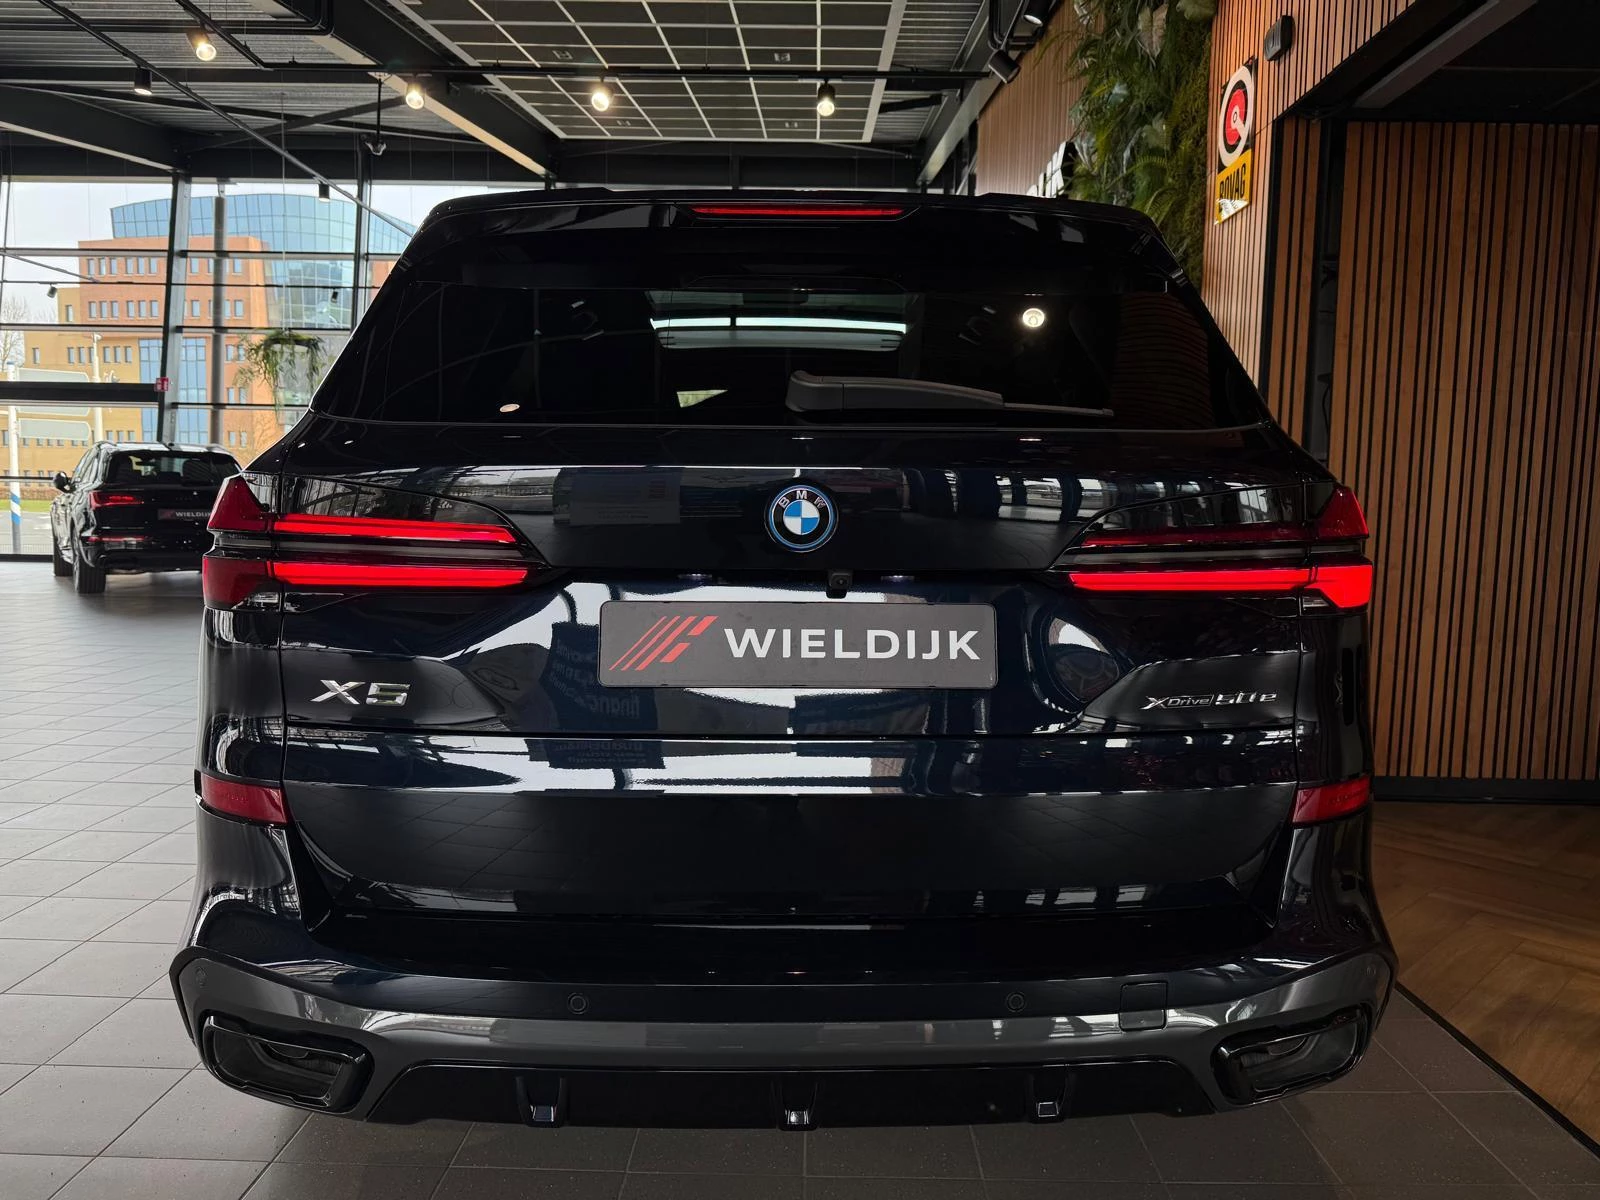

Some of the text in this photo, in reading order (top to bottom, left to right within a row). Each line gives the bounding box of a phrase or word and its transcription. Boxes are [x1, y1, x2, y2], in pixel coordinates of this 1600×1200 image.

[778, 490, 826, 509] BMW
[724, 628, 980, 660] WIELDIJK
[310, 679, 411, 706] X5
